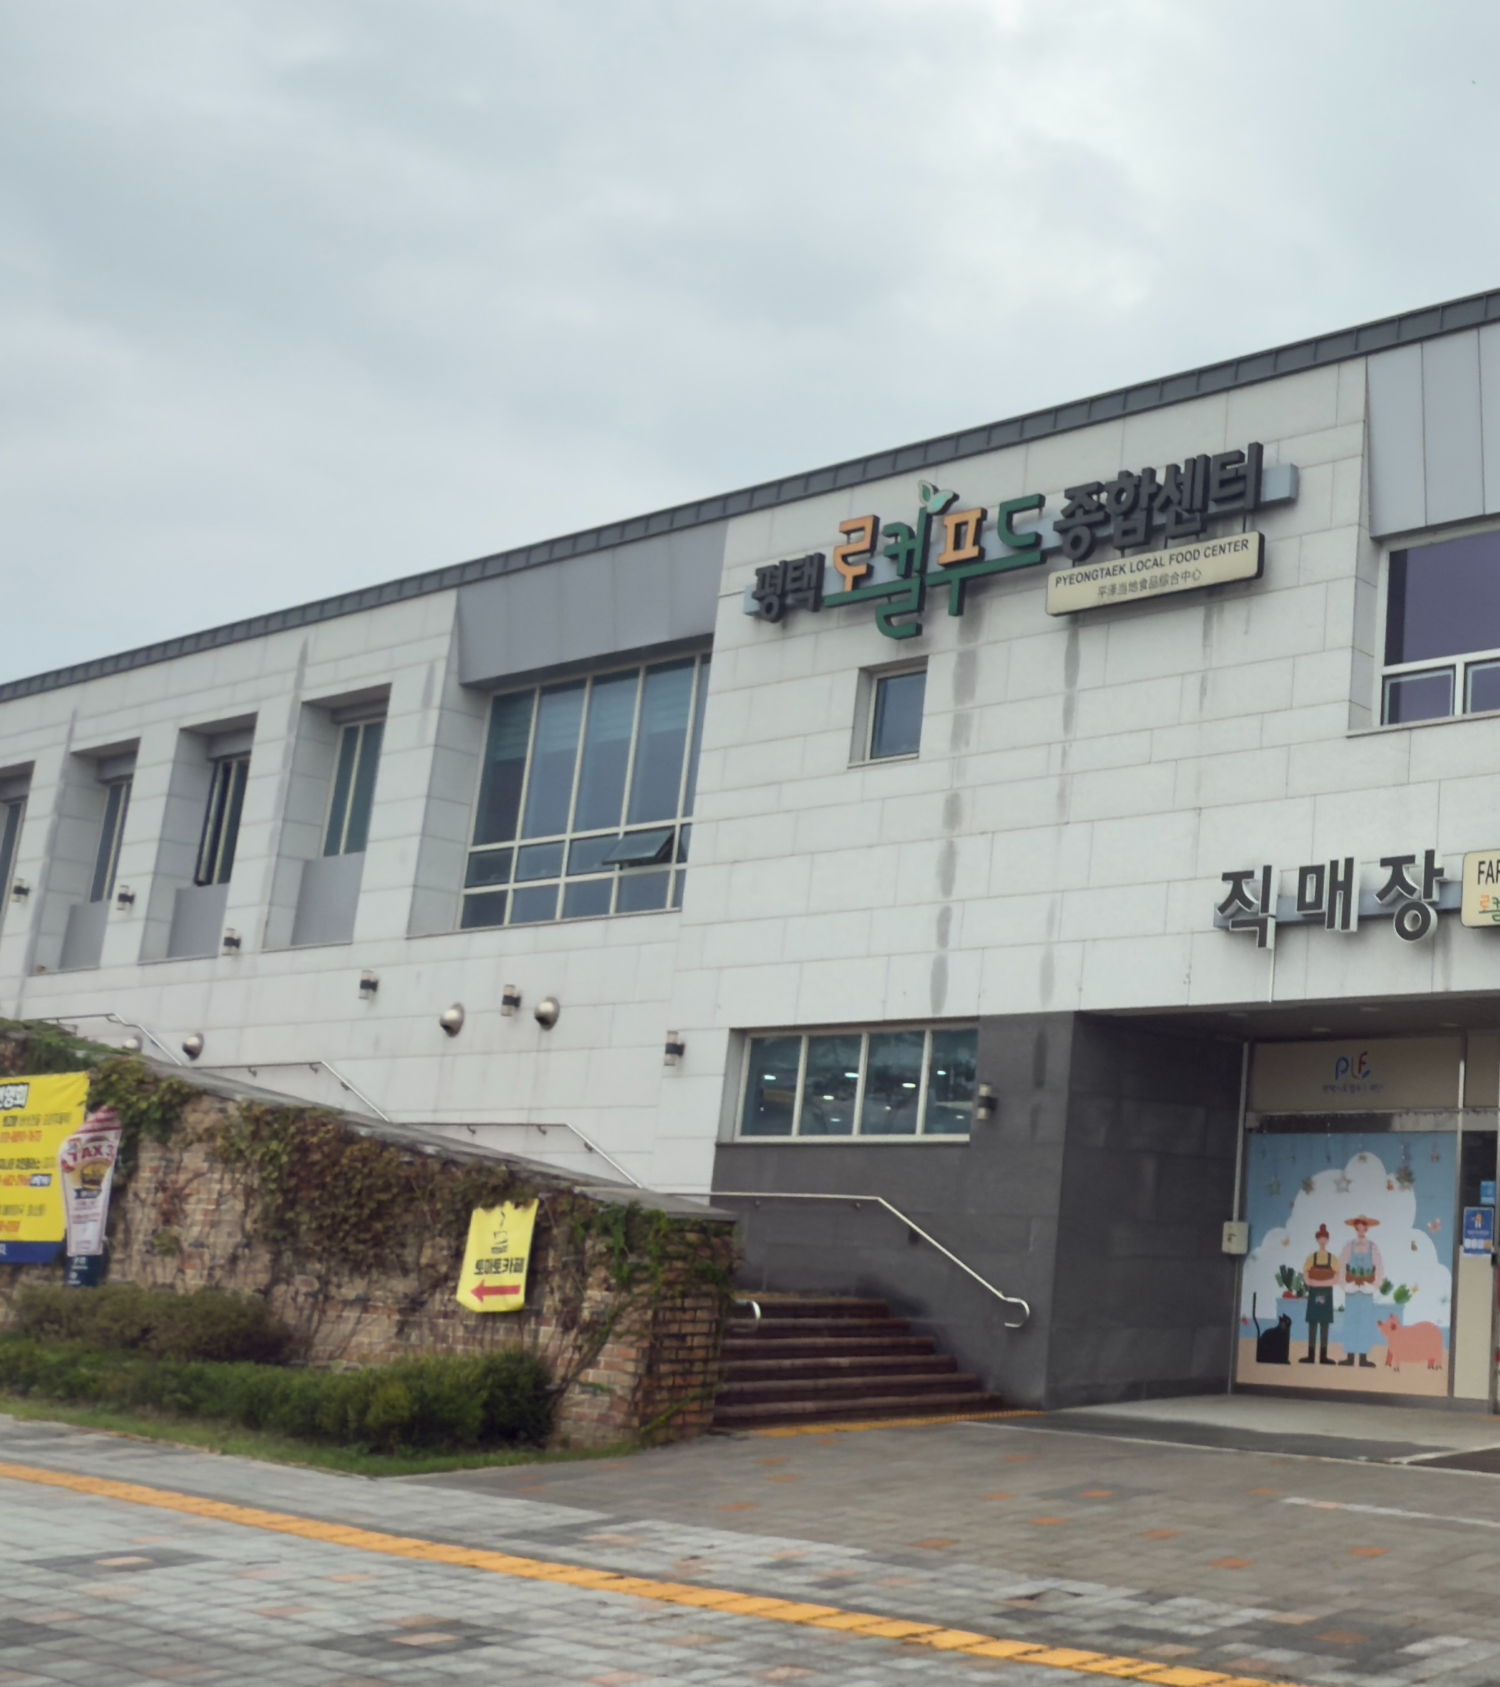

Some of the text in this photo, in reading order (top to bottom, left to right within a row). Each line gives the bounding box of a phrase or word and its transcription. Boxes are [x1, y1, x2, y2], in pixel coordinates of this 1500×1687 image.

[752, 441, 1264, 640] 평택 로컬푸드 종합센터
[1055, 538, 1249, 588] PYEONGTAEK LOCAL FOOD CENTER
[1216, 849, 1447, 950] 직매장
